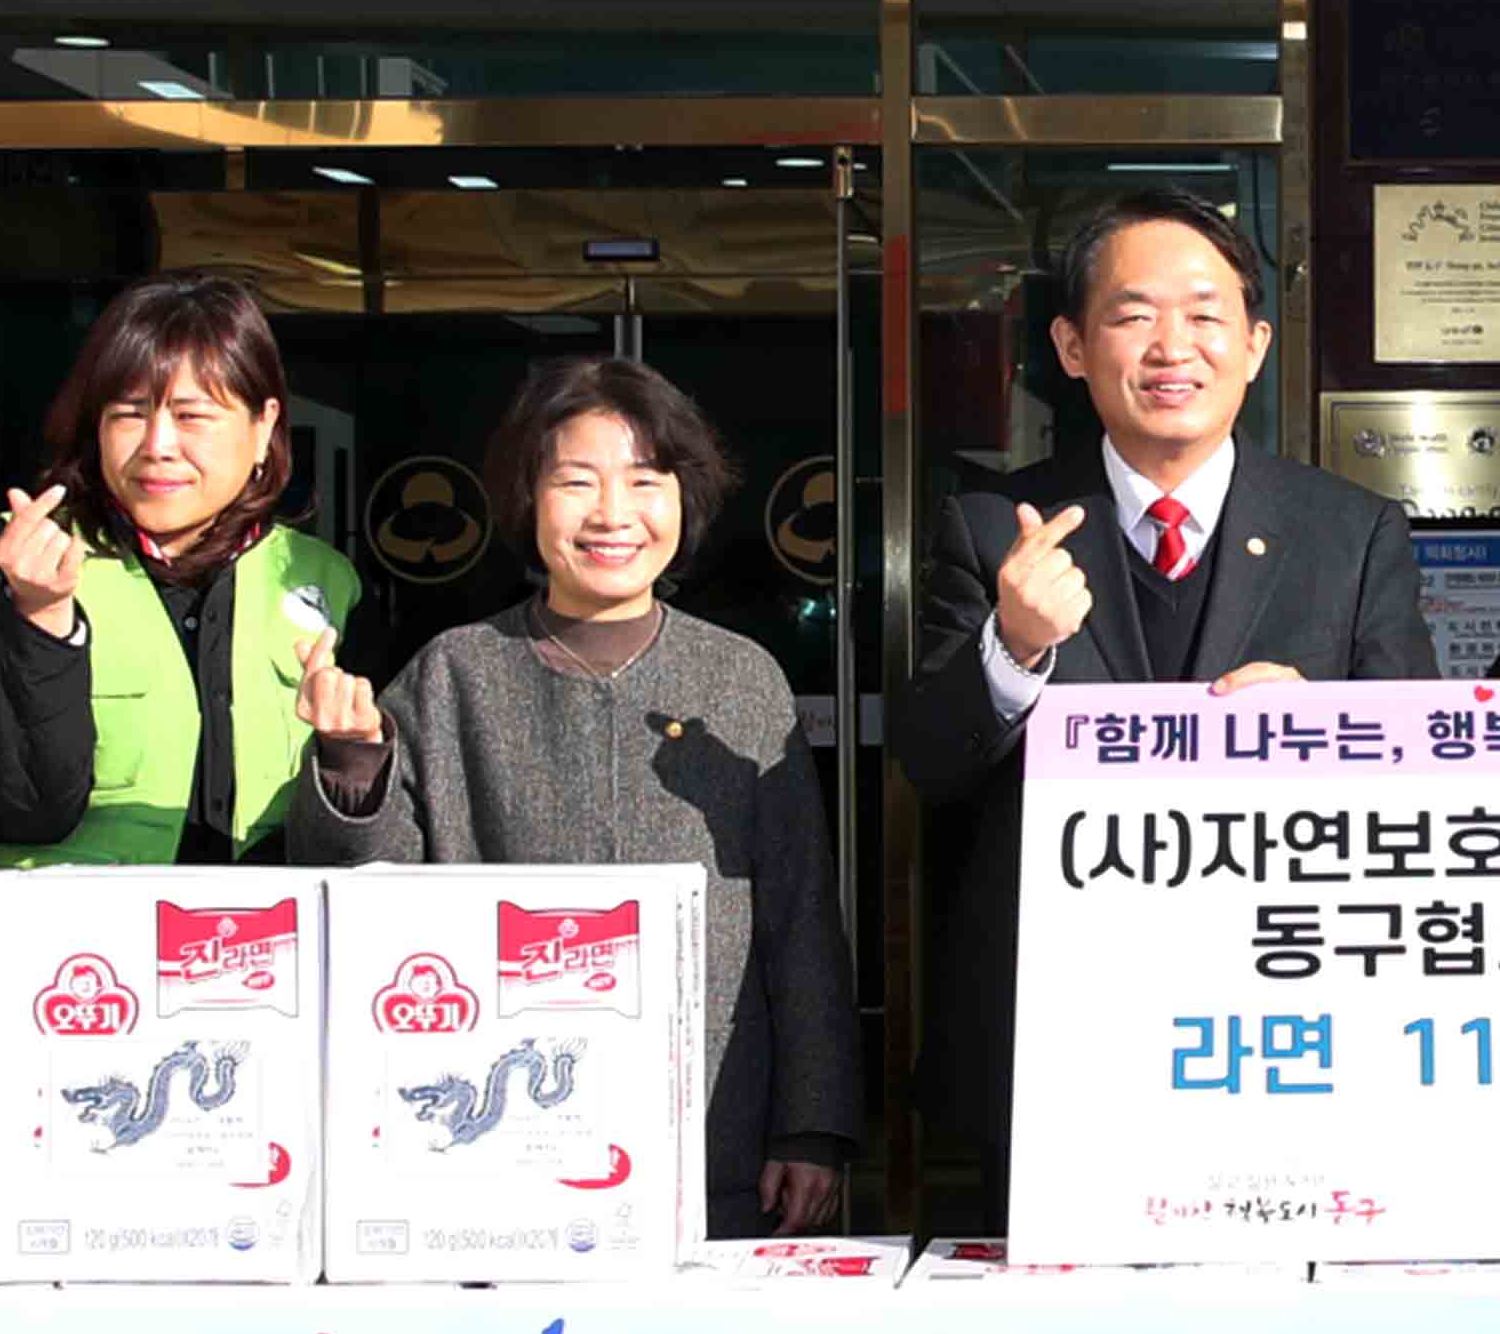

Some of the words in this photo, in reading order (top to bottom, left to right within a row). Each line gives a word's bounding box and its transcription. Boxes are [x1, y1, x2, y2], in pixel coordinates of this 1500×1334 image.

[1064, 712, 1200, 764] 『함께
[1225, 711, 1405, 766] 나누는,
[180, 938, 276, 981] 진라면
[522, 938, 619, 981] 진라면
[53, 1002, 120, 1033] 오뚜기
[392, 1002, 460, 1033] 오뚜기
[1172, 1013, 1334, 1096] 라면
[1324, 1190, 1386, 1226] 동구
